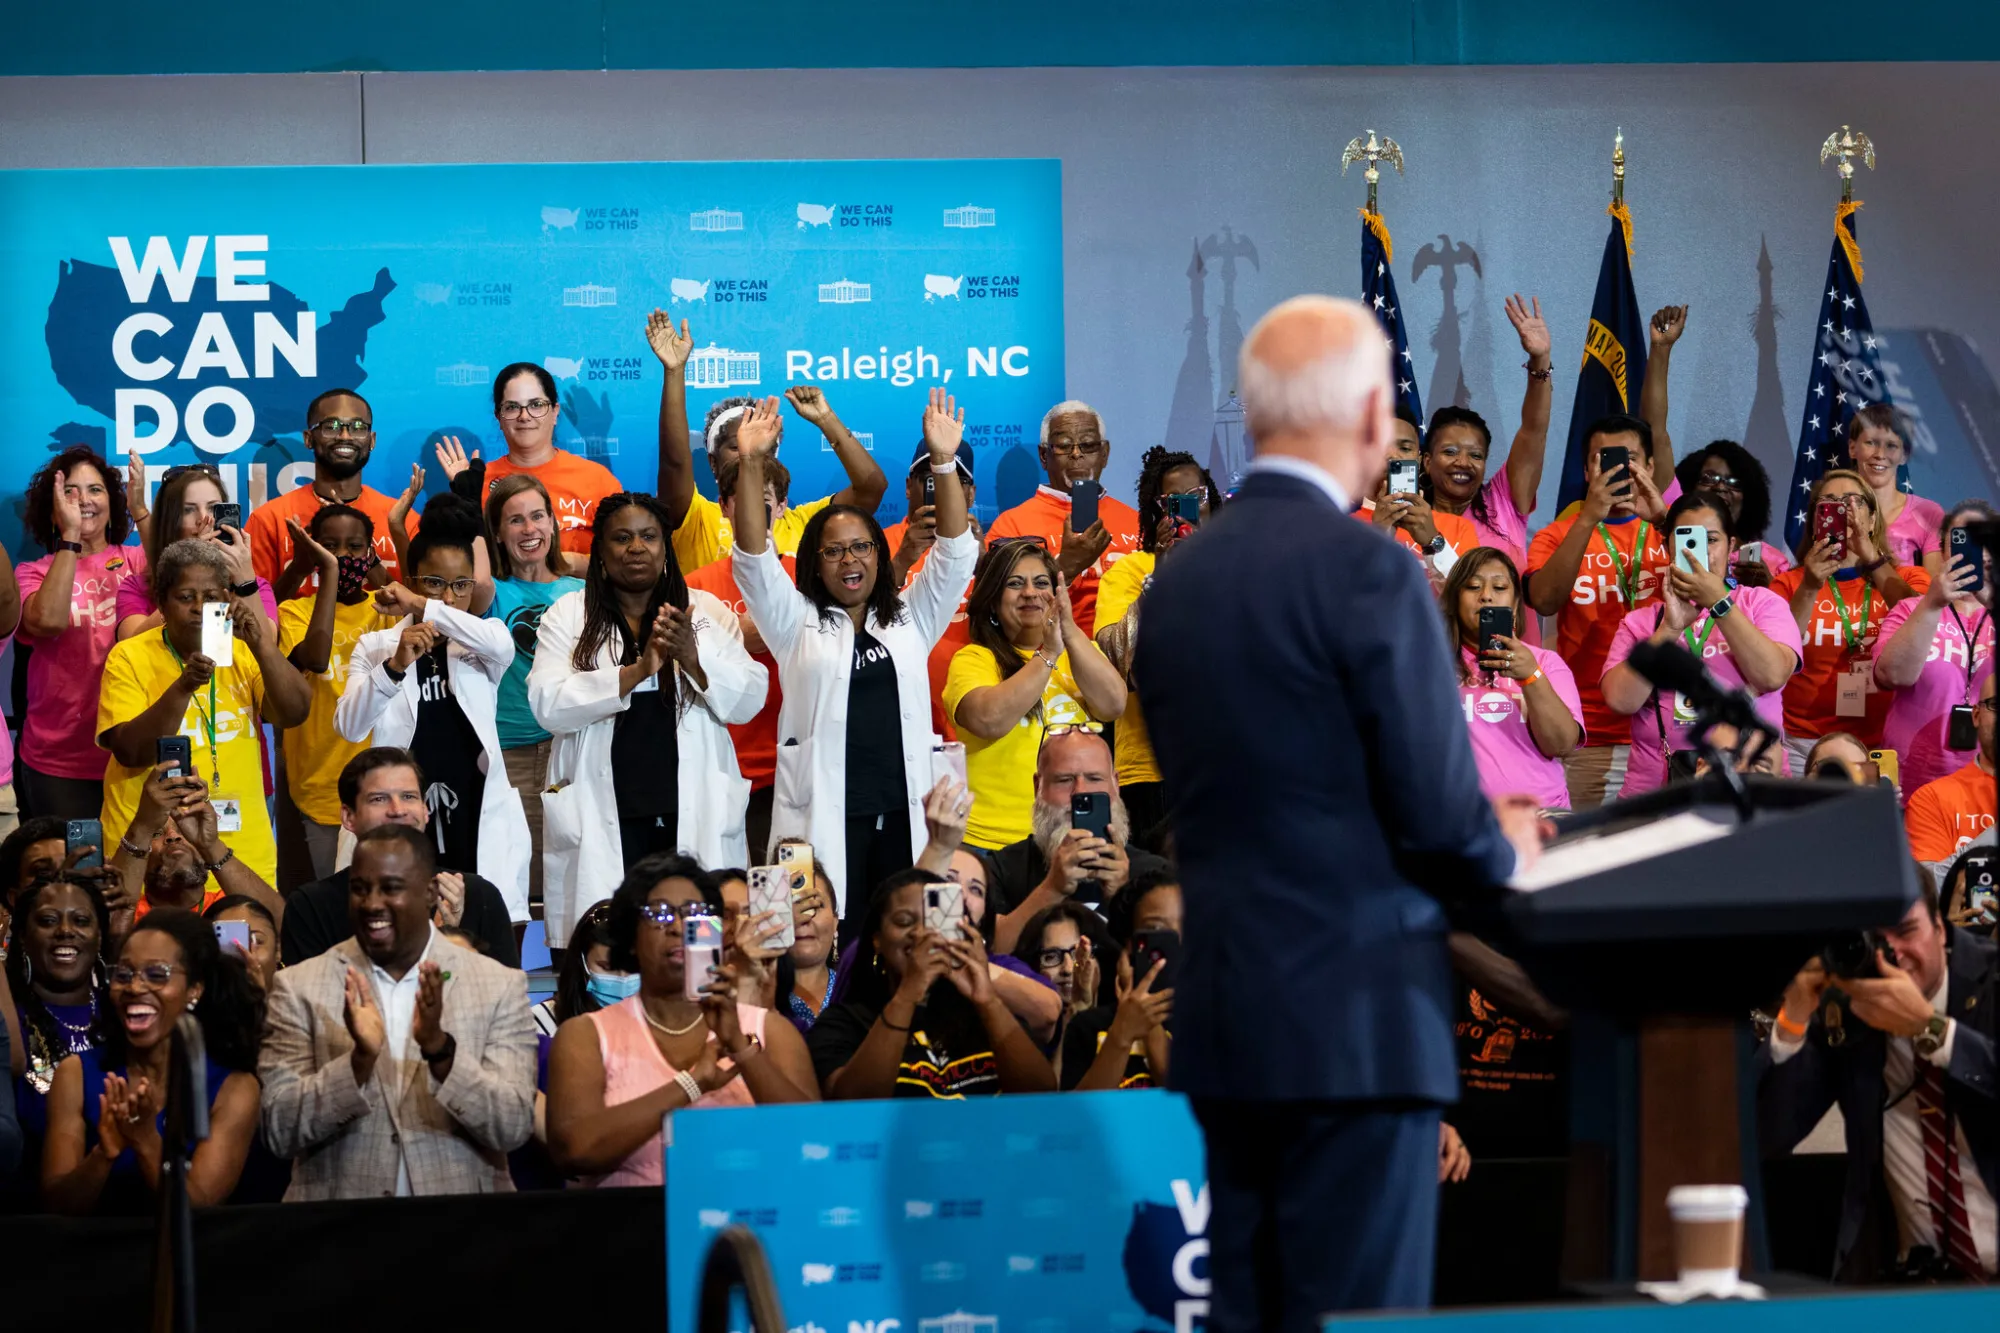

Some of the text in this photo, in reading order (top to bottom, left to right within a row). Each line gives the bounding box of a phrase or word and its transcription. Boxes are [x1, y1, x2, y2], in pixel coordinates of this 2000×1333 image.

[584, 207, 639, 218] WE CAN
[839, 204, 894, 215] WE CAN
[584, 219, 639, 230] DO THIS
[839, 216, 893, 227] DO THIS
[108, 235, 270, 303] WE
[714, 279, 768, 290] WE CAN
[967, 275, 1021, 286] WE CAN
[457, 283, 512, 294] WE CAN
[967, 287, 1019, 298] DO THIS
[457, 295, 512, 306] DO THIS
[714, 291, 767, 302] DO THIS
[112, 311, 317, 381] CAN
[1586, 323, 1614, 358] MAY
[587, 358, 642, 369] WE CAN
[786, 345, 1030, 387] Raleigh, NC
[587, 370, 642, 381] DO THIS
[115, 386, 255, 455] DO
[969, 425, 1022, 435] WE CAN
[969, 436, 1021, 447] DO THIS
[559, 497, 592, 516] MY
[71, 577, 111, 597] OOK
